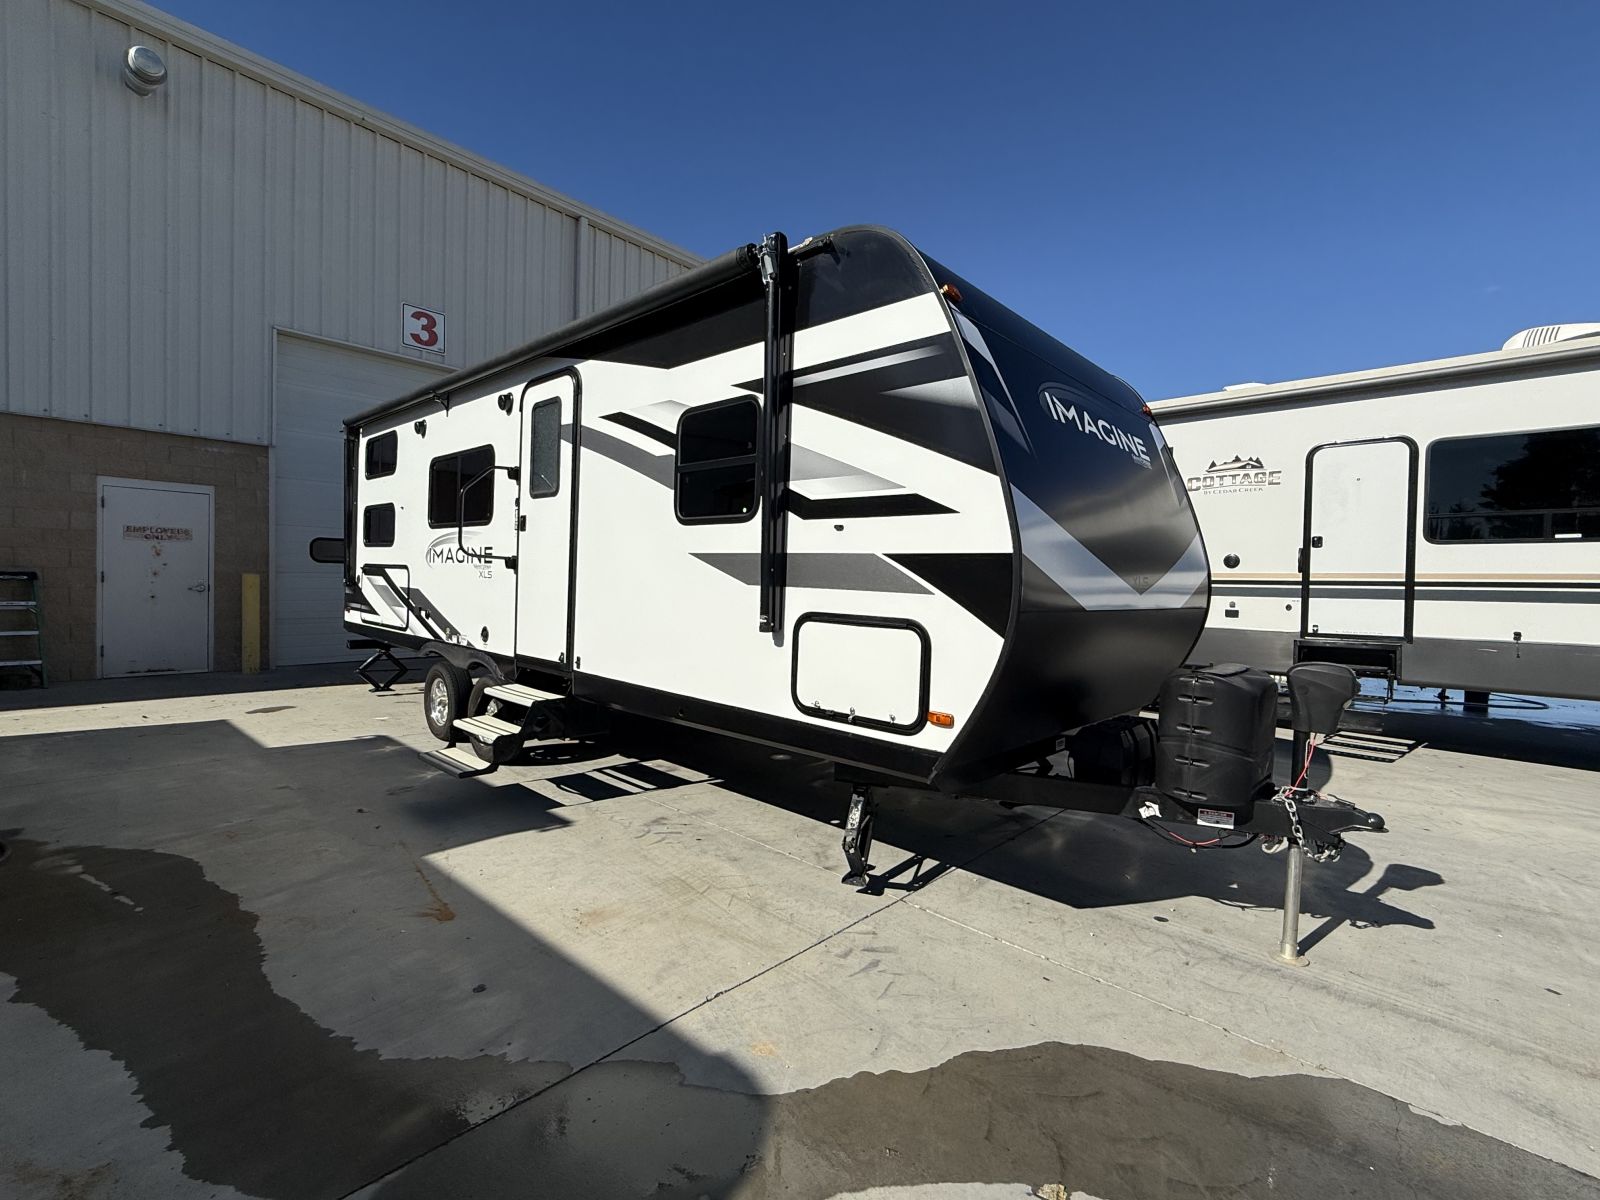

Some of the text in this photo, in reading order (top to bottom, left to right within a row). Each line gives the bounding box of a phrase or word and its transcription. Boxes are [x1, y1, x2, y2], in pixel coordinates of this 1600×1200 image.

[410, 311, 438, 346] 3
[1044, 391, 1151, 462] IMAGINE
[1187, 470, 1282, 492] COTTAGE
[429, 546, 493, 564] IMAGINE
[478, 570, 493, 579] XLS
